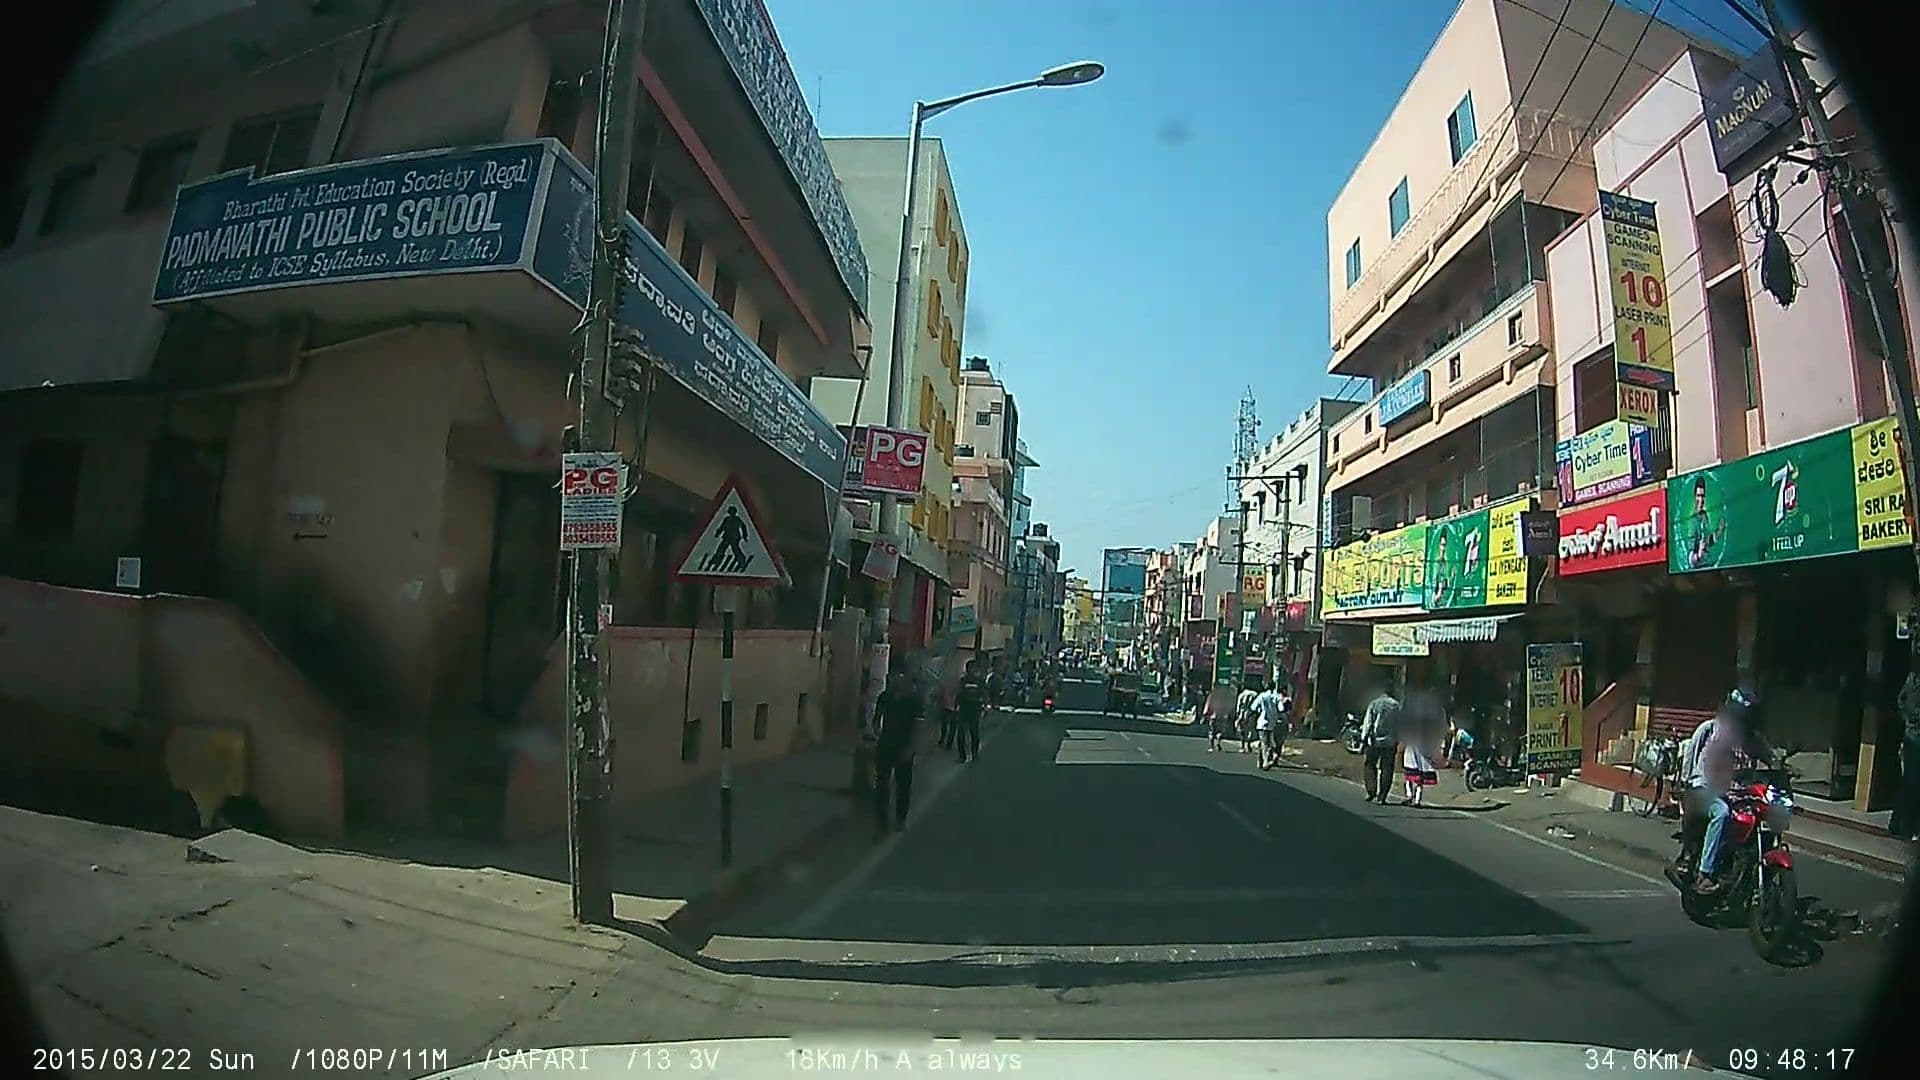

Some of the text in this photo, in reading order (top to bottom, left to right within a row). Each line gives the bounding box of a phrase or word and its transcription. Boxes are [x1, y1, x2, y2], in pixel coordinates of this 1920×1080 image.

[1715, 80, 1773, 139] MAGNUM
[223, 192, 288, 220] Bharathi
[312, 178, 396, 206] Education
[401, 165, 476, 194] Society
[166, 190, 502, 269] PADMAVATHI PUBLIC SCHOOL
[1606, 233, 1660, 256] SCANNING
[1614, 223, 1651, 242] GAMES
[249, 261, 264, 280] to
[268, 254, 308, 278] ICSE
[395, 242, 436, 265] New
[1620, 271, 1663, 309] 10
[1614, 306, 1668, 329] LASER PRINT
[1631, 326, 1647, 363] 1
[1620, 387, 1657, 415] XEROX
[870, 432, 923, 468] PG
[1575, 450, 1603, 474] Cyber
[1603, 442, 1628, 462] Time
[565, 467, 618, 491] PG
[1864, 495, 1886, 516] SRI
[1601, 506, 1661, 556] Amul
[1861, 517, 1912, 541] BAKERY
[1559, 667, 1581, 705] 10
[1530, 732, 1558, 749] PRINT
